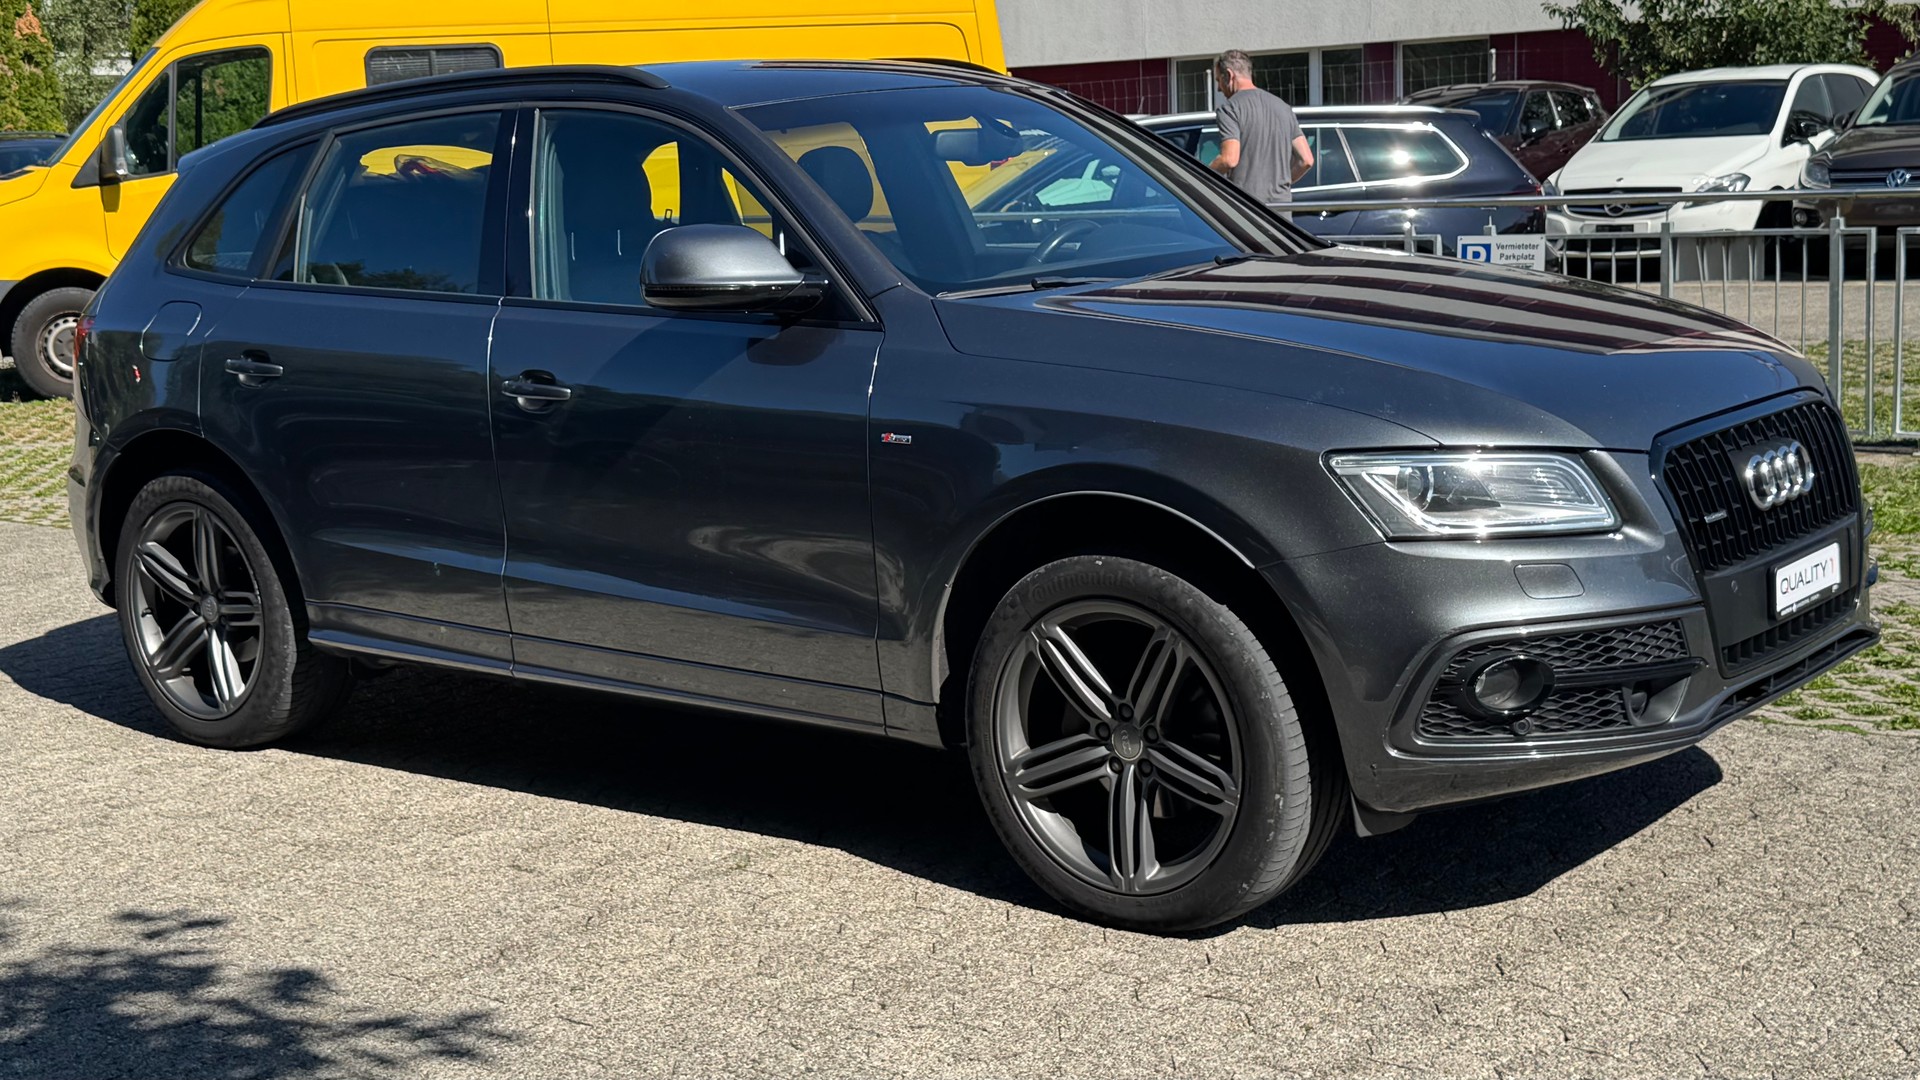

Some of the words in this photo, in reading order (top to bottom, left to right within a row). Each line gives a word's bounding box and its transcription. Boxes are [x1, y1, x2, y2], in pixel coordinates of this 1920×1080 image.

[1495, 242, 1540, 251] Vermieteter
[1499, 252, 1536, 262] Parkplatz
[1028, 570, 1123, 602] Continental
[1780, 559, 1828, 595] QUALITY
